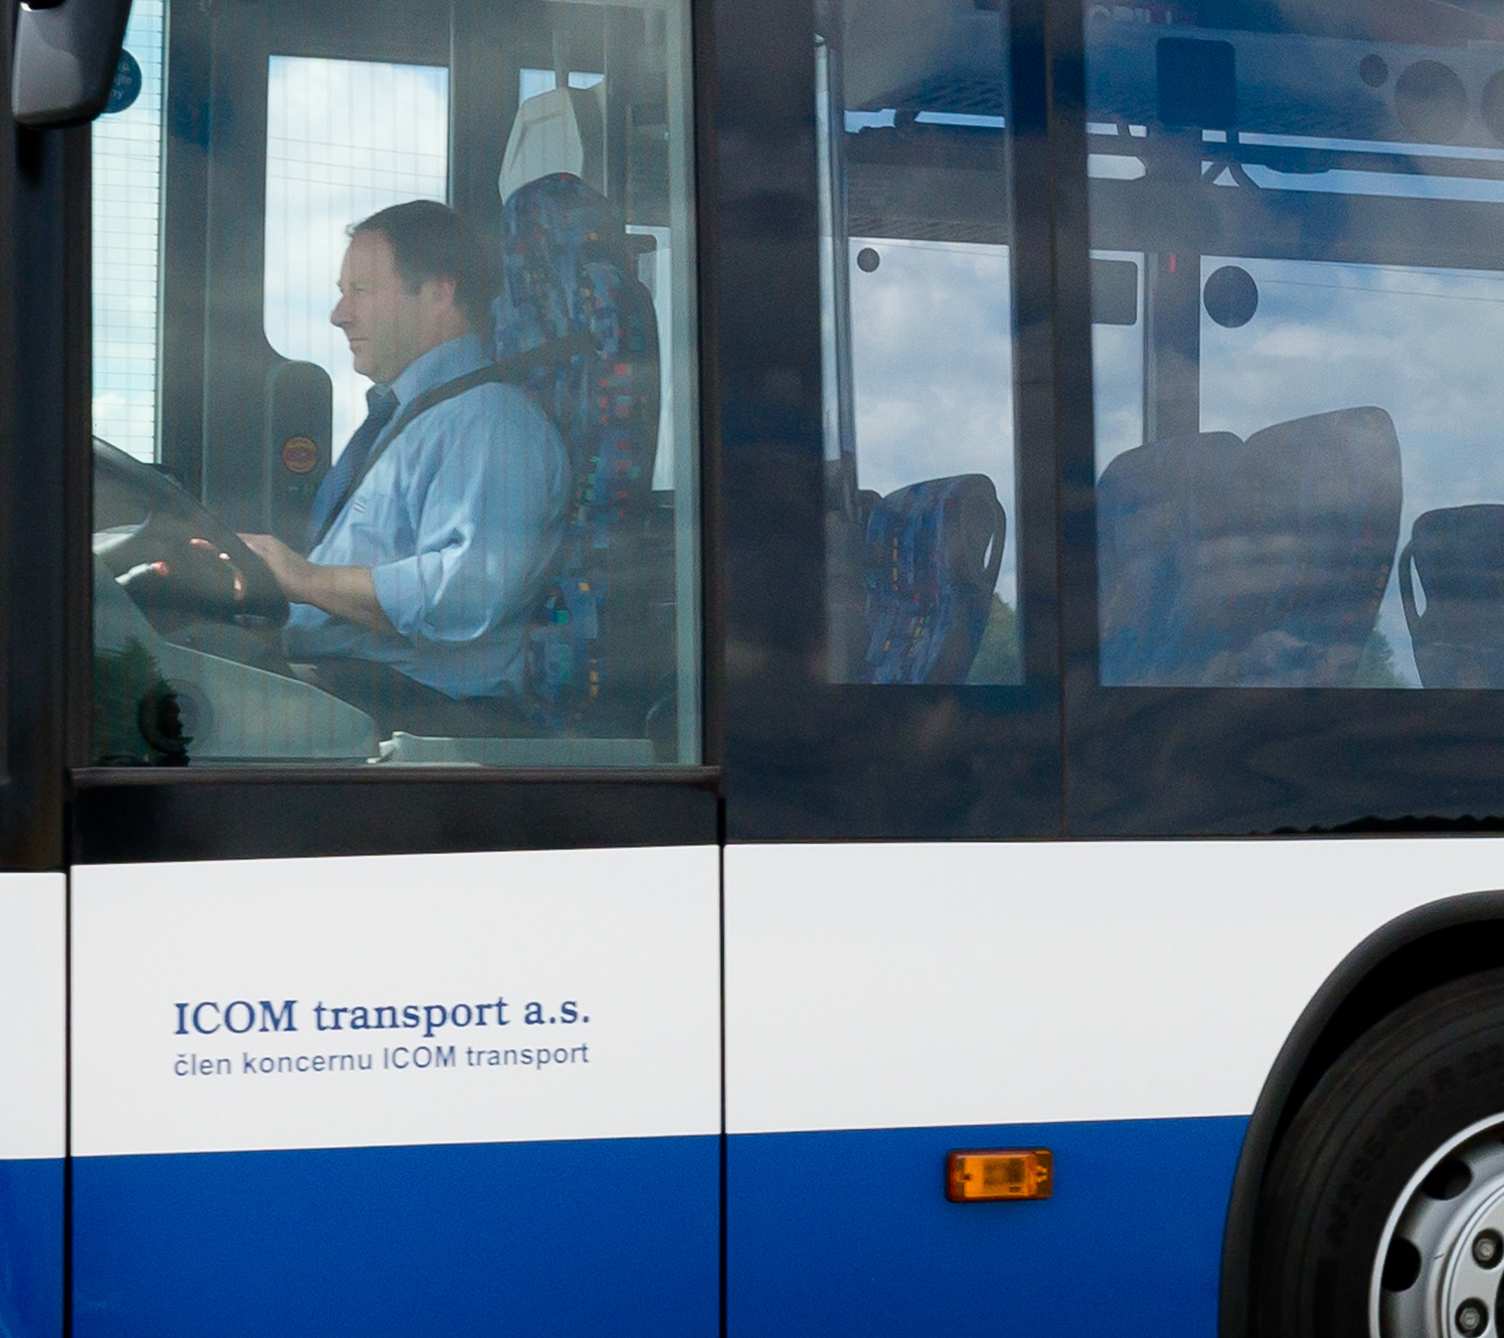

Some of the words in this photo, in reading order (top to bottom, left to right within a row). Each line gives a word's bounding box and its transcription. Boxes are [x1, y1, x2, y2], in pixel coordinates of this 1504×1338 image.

[174, 1000, 298, 1035] ICOM
[314, 996, 510, 1038] transport
[524, 999, 591, 1026] a.s.
[174, 1053, 232, 1077] člen
[243, 1051, 373, 1075] koncernu
[383, 1045, 457, 1070] ICOM
[466, 1043, 590, 1072] transport
